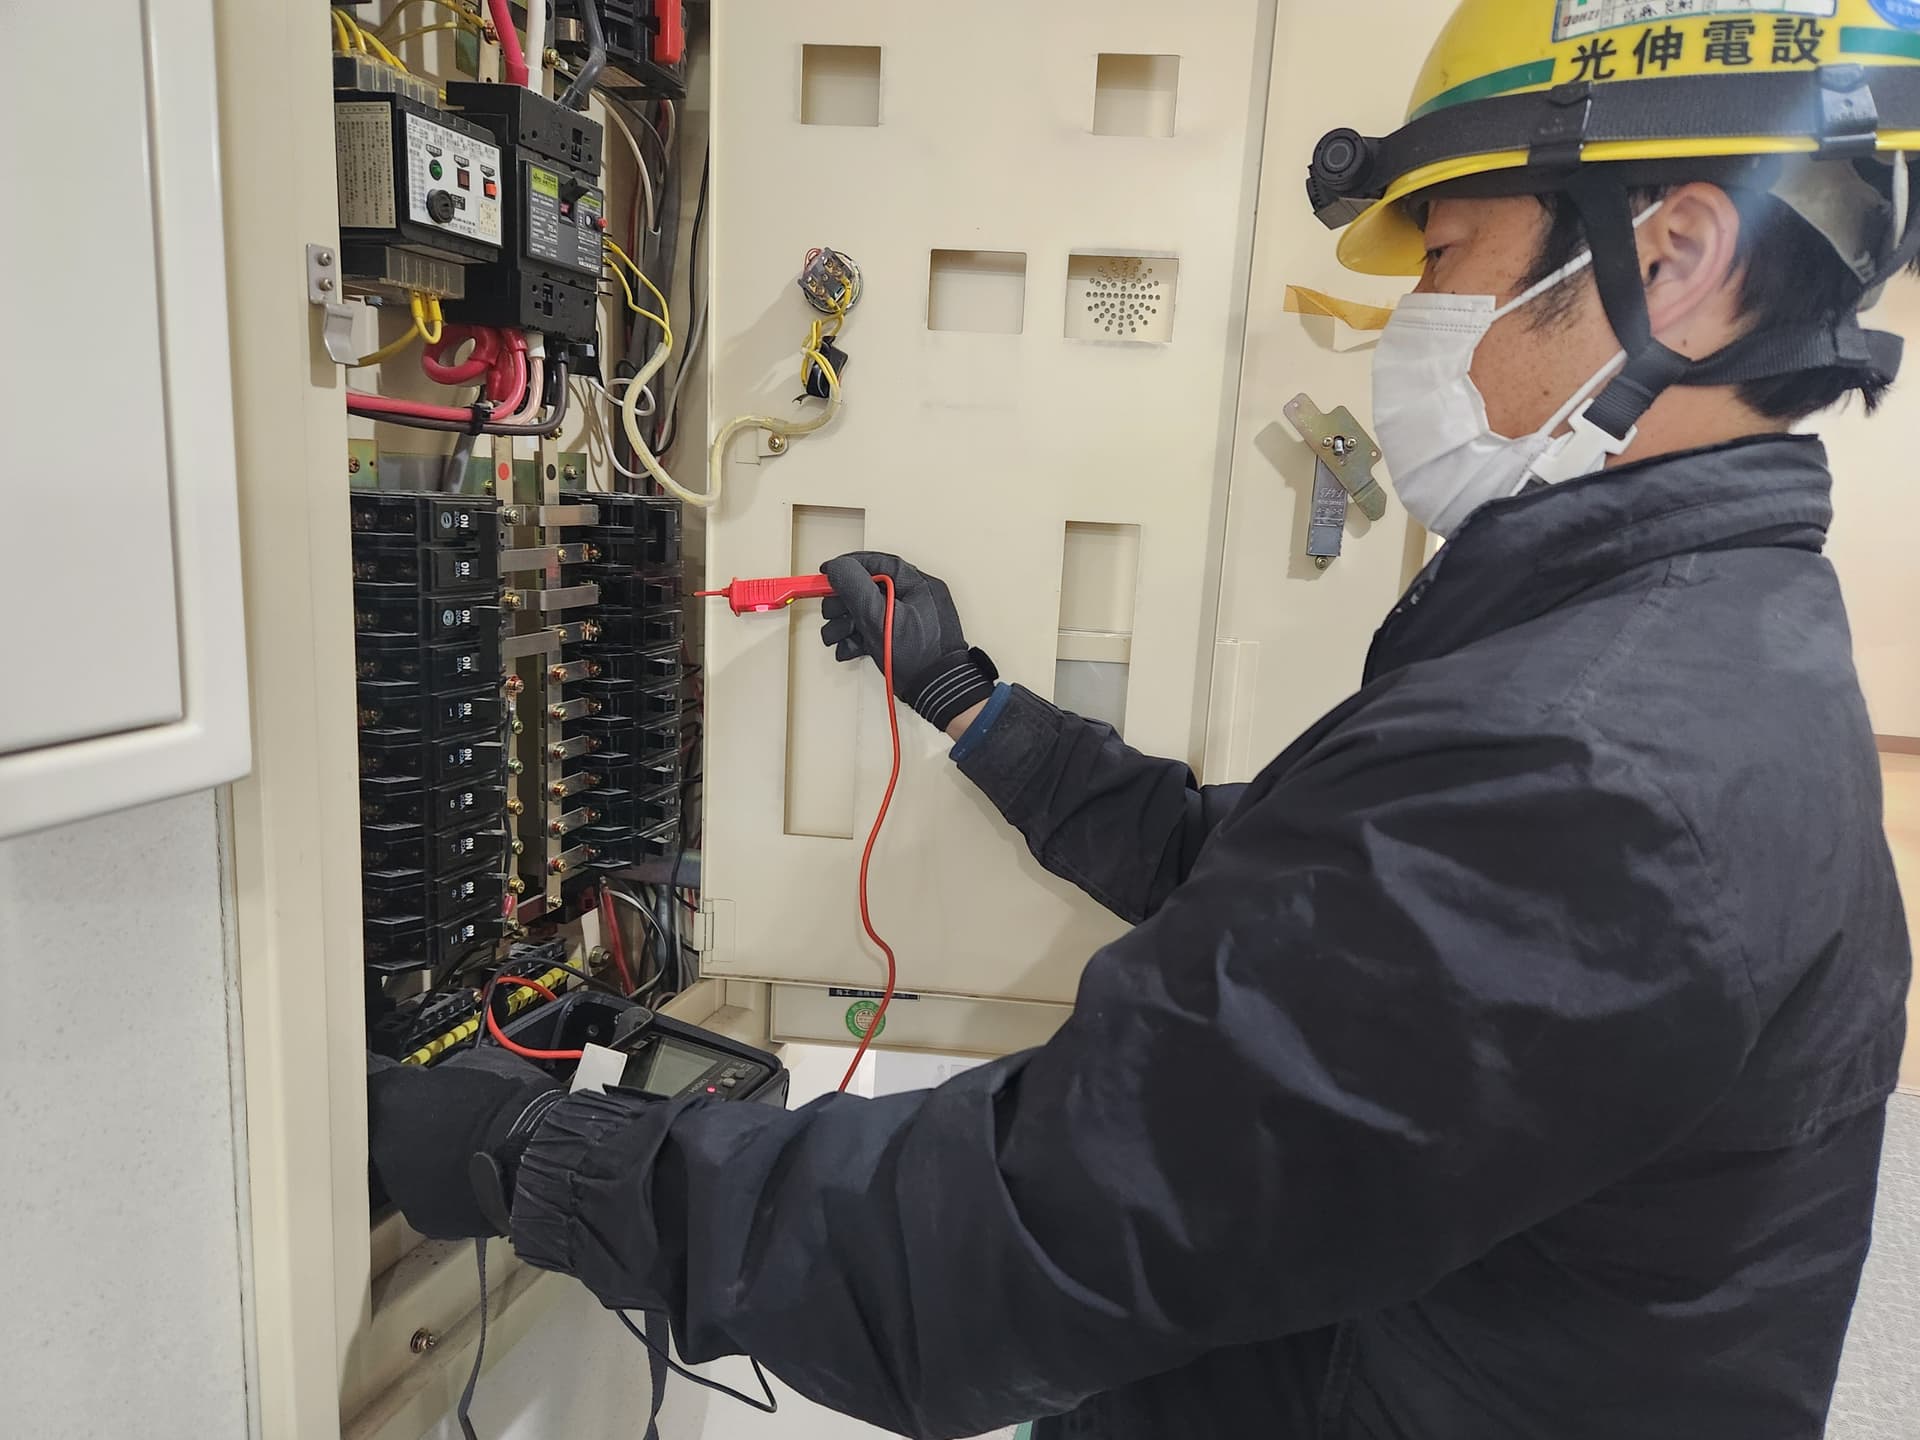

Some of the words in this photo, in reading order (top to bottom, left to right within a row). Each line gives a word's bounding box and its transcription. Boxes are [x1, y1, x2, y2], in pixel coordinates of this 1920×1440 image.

[1571, 18, 1824, 82] 光伸電設
[460, 514, 469, 528] ON
[461, 562, 470, 575] ON
[462, 610, 470, 623] ON
[463, 656, 471, 670] ON
[464, 703, 472, 715] ON
[464, 748, 472, 760] ON
[465, 792, 473, 805] ON
[466, 837, 474, 850] ON
